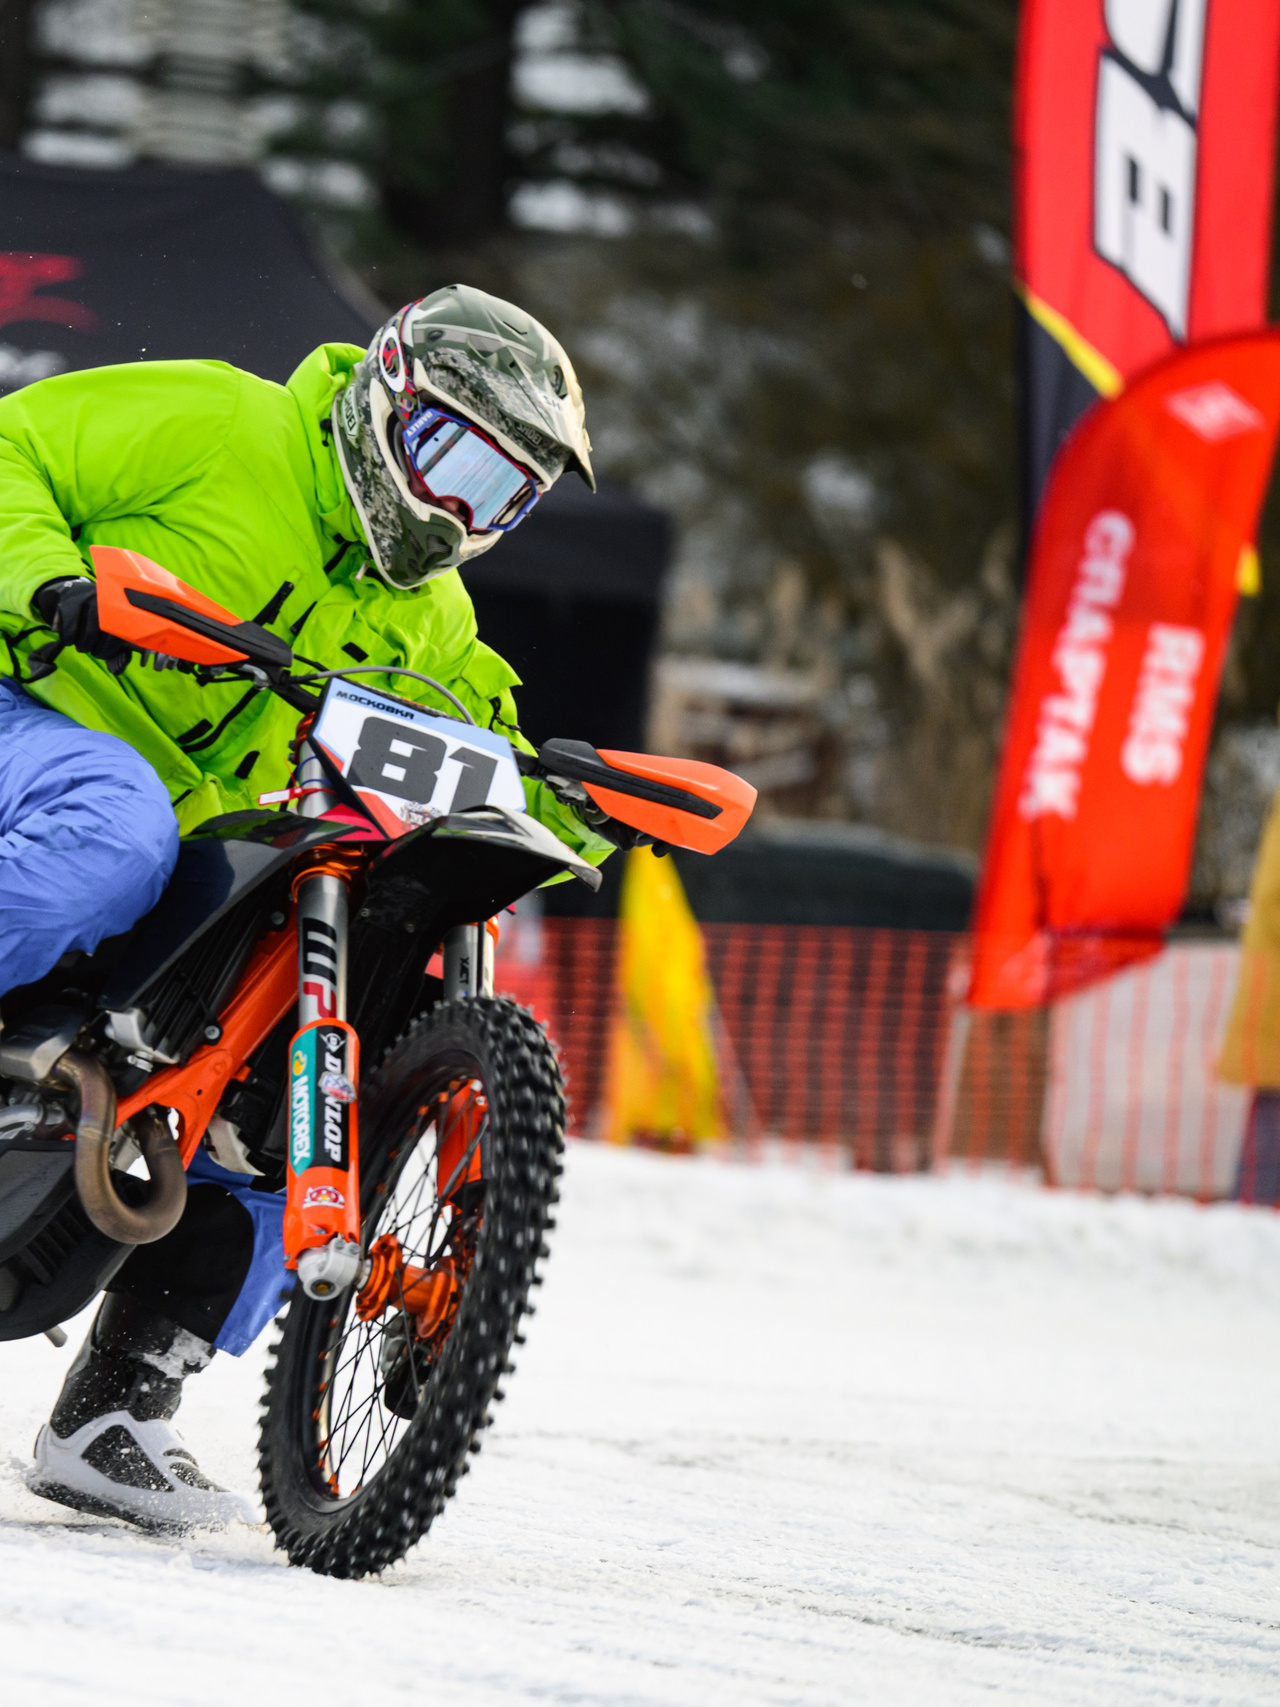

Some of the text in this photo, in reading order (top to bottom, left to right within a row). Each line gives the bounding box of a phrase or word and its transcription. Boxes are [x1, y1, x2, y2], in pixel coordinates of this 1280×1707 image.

[406, 411, 433, 437] OAKLEY
[336, 690, 415, 720] МОСКОВКА
[345, 716, 499, 814] 81
[459, 956, 470, 984] XACT
[291, 1075, 311, 1165] MOTOREX
[324, 1051, 342, 1163] DNLOP
